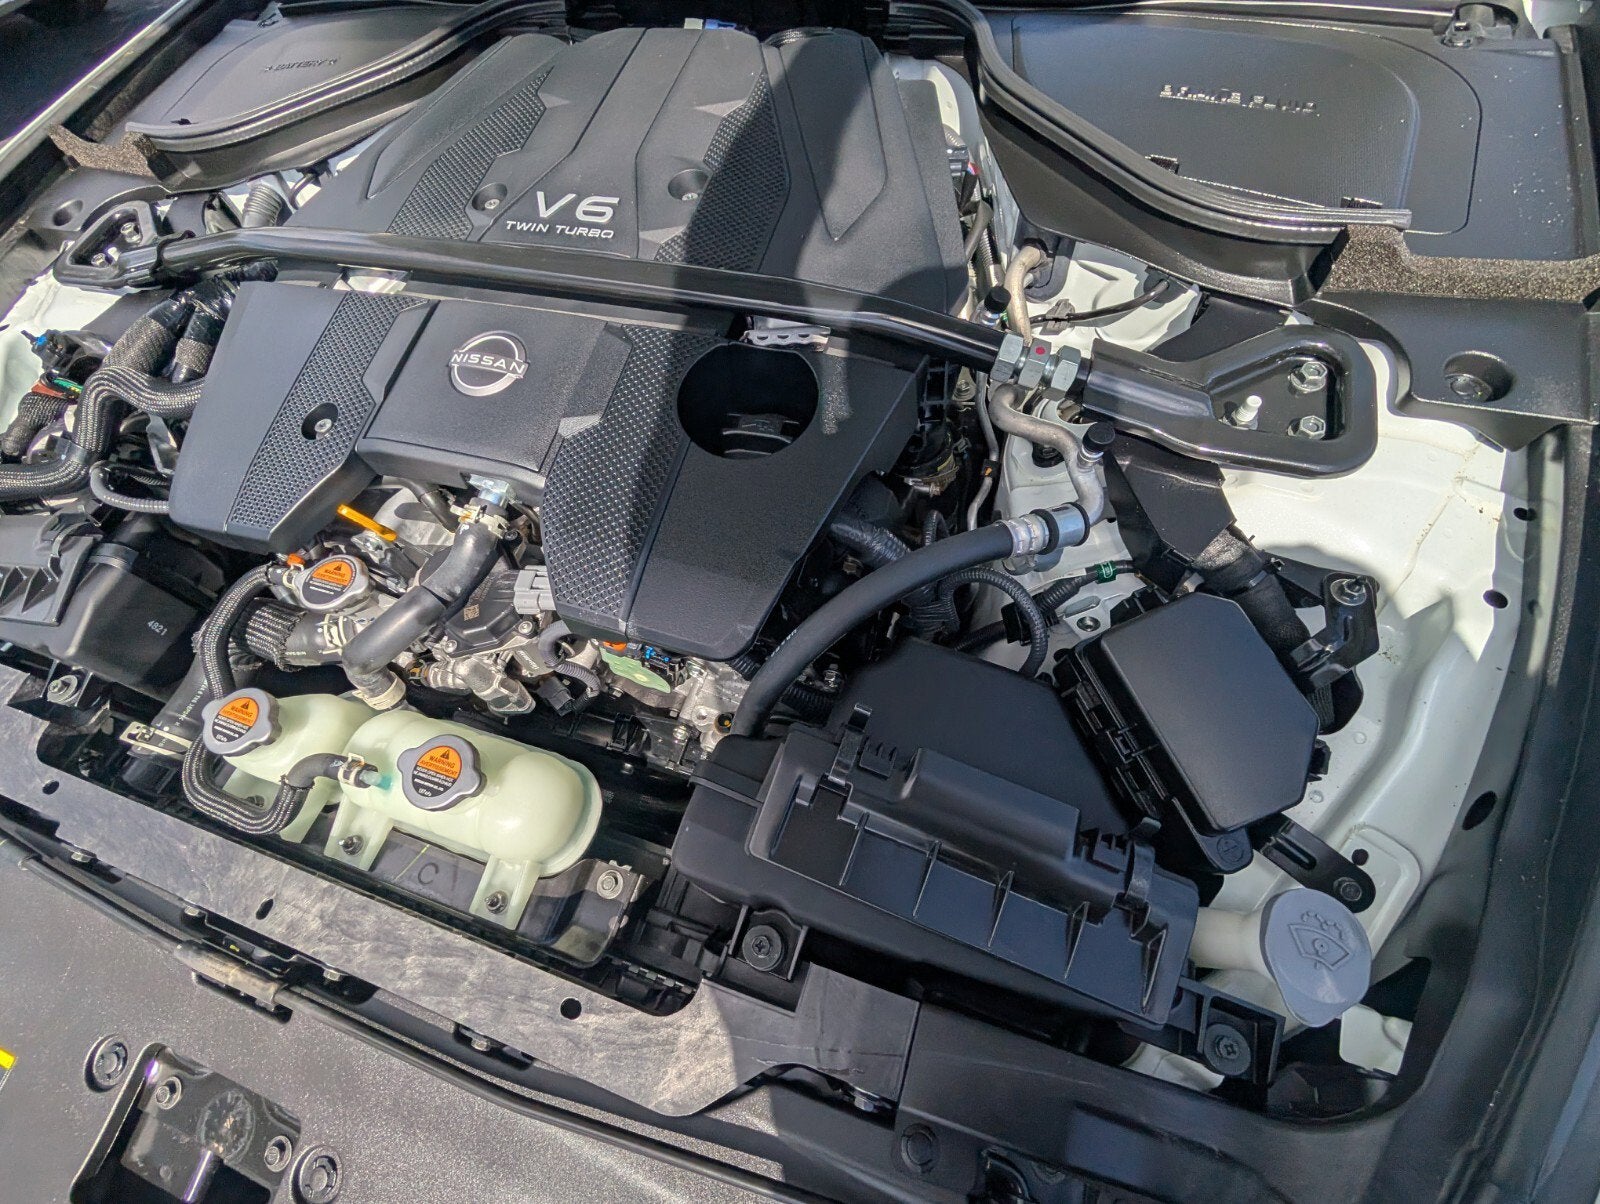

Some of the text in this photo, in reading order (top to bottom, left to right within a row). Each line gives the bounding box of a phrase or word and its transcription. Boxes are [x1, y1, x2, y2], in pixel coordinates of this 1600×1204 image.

[536, 190, 620, 223] V6
[506, 220, 615, 239] TWIN TURBO
[451, 353, 525, 374] NISSAN
[147, 620, 168, 636] 4821
[429, 755, 456, 769] WARNING
